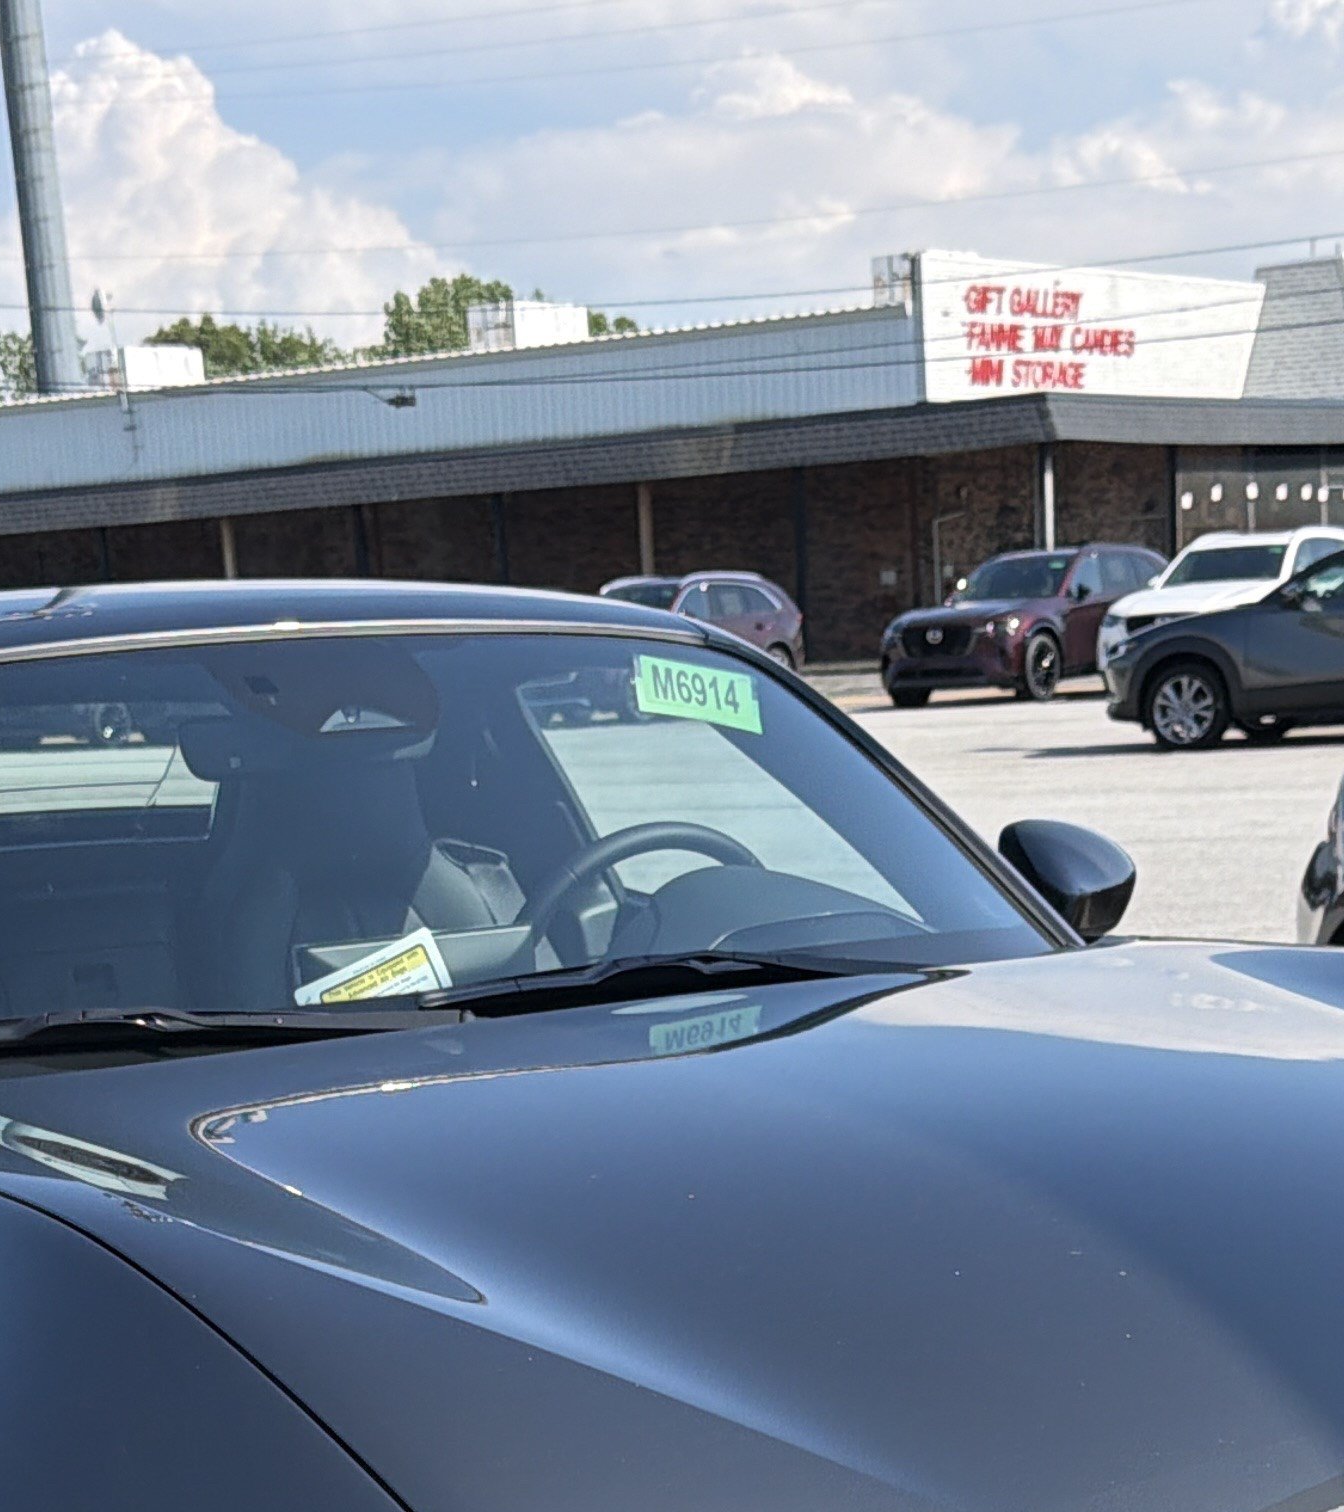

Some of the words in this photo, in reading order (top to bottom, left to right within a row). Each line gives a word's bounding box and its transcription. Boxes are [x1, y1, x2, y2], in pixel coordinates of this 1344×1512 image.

[964, 285, 1006, 315] GIFT
[1010, 287, 1083, 320] GALLERY
[1012, 360, 1085, 389] STORAGE
[651, 664, 740, 714] M6914
